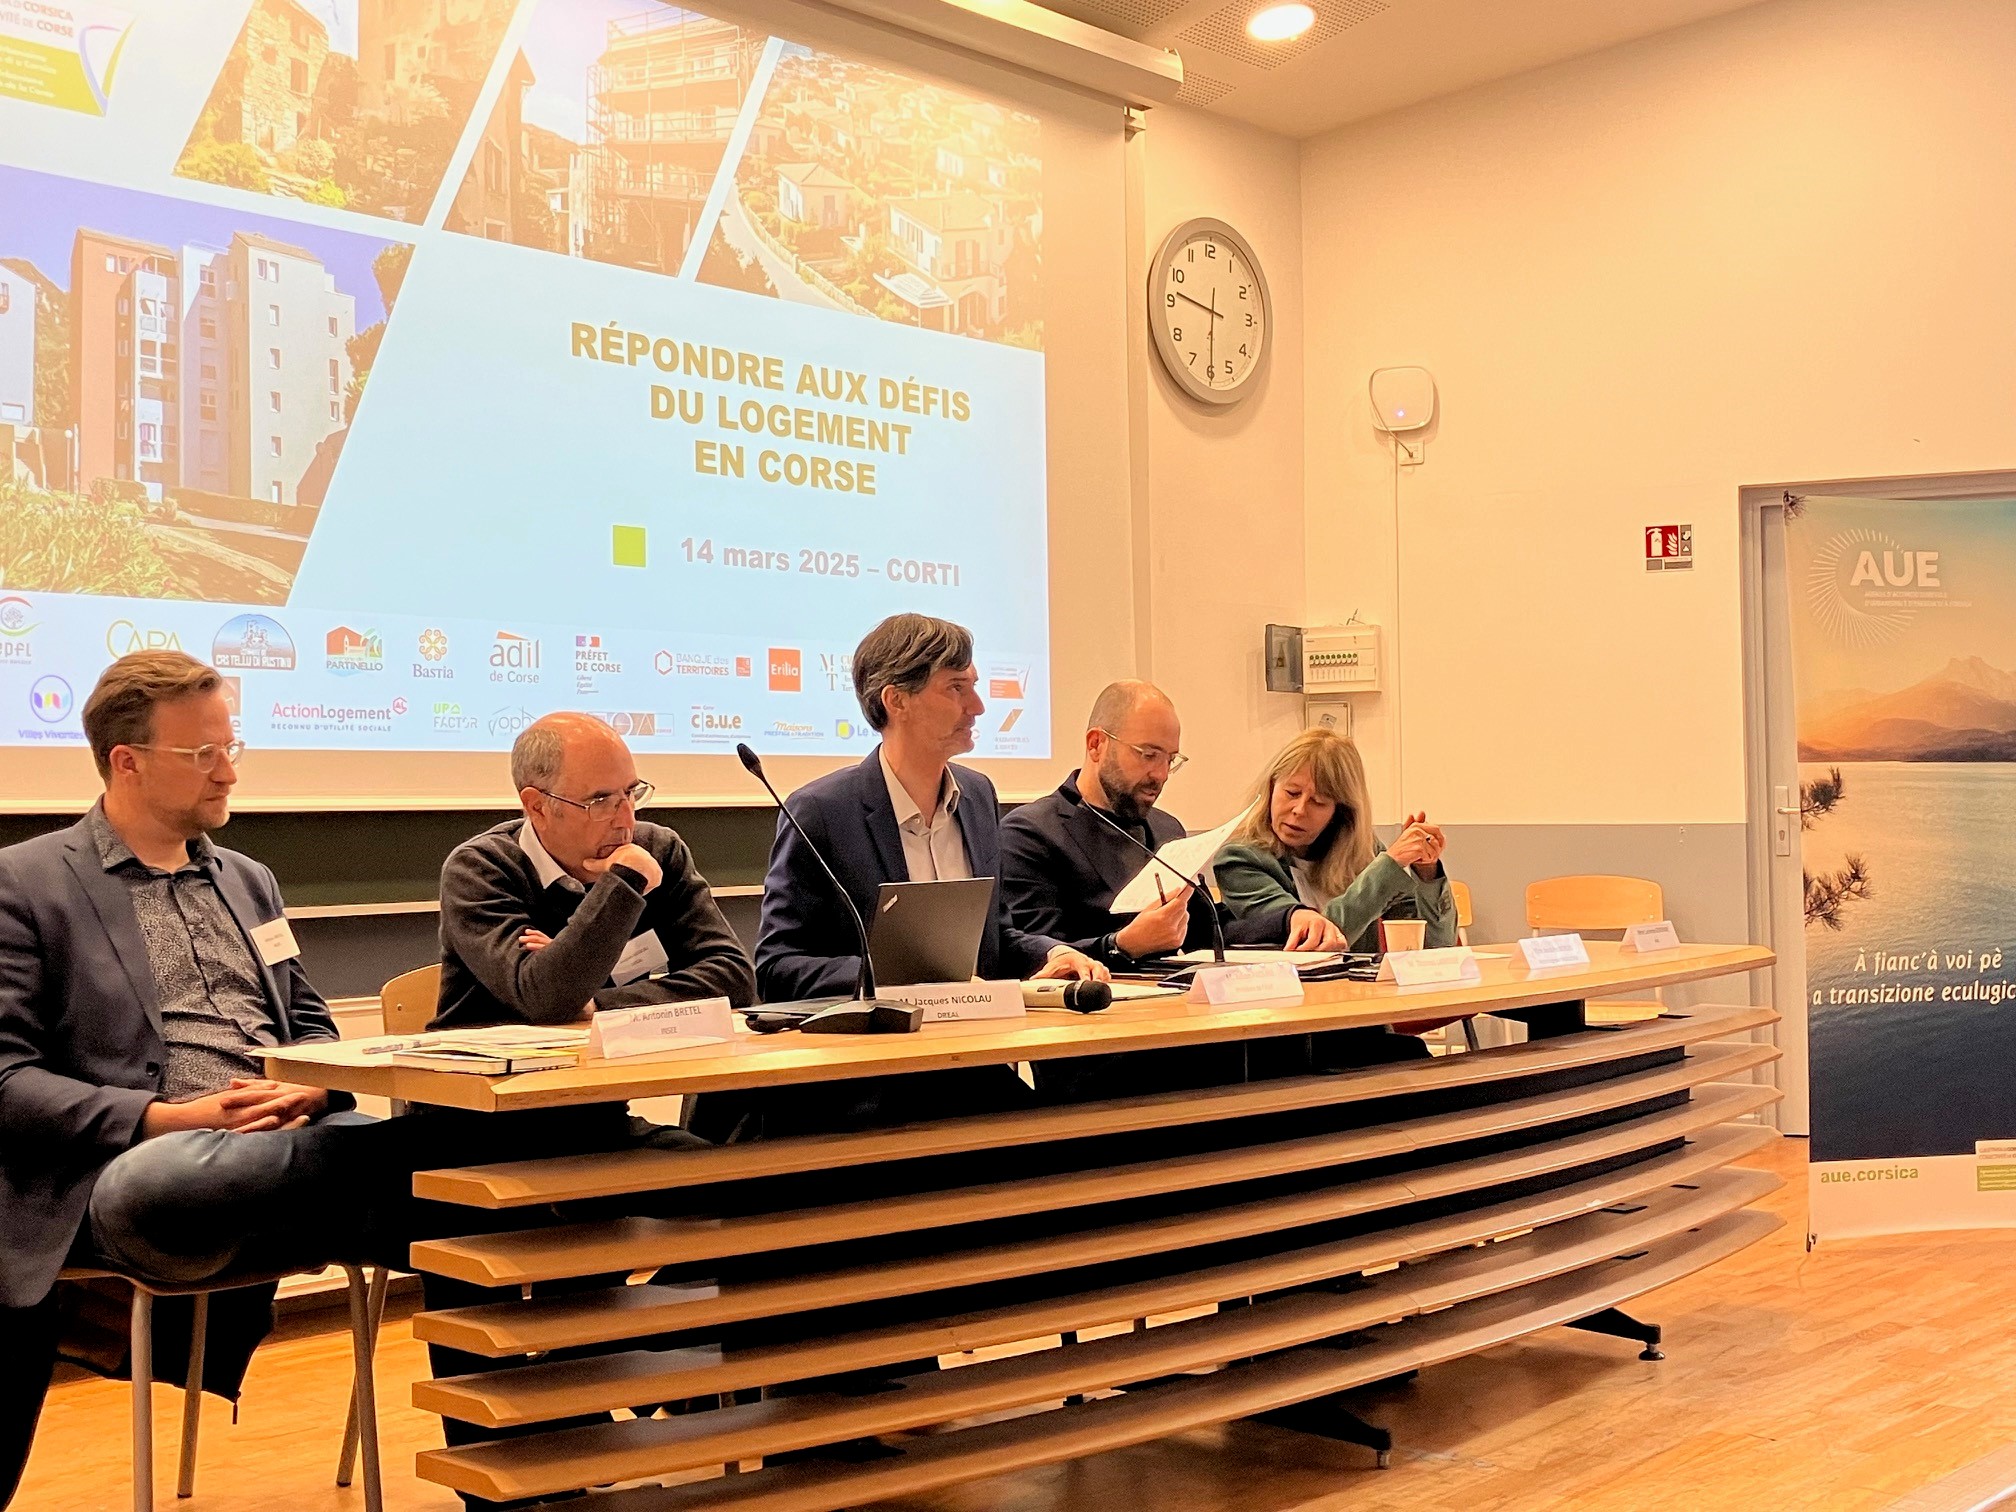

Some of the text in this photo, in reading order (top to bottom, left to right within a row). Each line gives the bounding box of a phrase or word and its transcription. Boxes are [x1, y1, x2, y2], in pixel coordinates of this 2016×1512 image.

[23, 1, 75, 22] CORSICA
[36, 20, 74, 38] CORSE
[1188, 248, 1194, 263] 11
[1204, 243, 1216, 260] 12
[1228, 259, 1232, 274] 1
[1172, 267, 1185, 284] 10
[1167, 293, 1176, 308] 9
[1239, 286, 1247, 300] 2
[1245, 313, 1253, 327] 3
[1173, 327, 1182, 342] 8
[1238, 343, 1247, 357] 4
[1188, 352, 1197, 366] 7
[571, 320, 971, 422] RÉPONDRE AUX DÉFIS
[1206, 365, 1215, 380] 6
[1225, 360, 1233, 374] 5
[651, 384, 912, 455] DU LOGEMENT
[695, 440, 876, 495] EN CORSE
[681, 537, 714, 564] 14
[723, 544, 790, 571] mars
[799, 549, 860, 578] 2025
[887, 558, 960, 587] CORTI
[1850, 550, 1941, 587] AUE
[489, 639, 540, 670] adil
[575, 649, 608, 661] PRÉFET
[676, 653, 712, 664] BANQUE
[326, 660, 384, 671] PARTINELLO
[412, 663, 454, 679] Bastia
[575, 661, 621, 673] DE CORSE
[676, 664, 729, 676] TERRITOIRES
[770, 662, 799, 677] Erilia
[489, 671, 540, 684] de Corse
[271, 702, 392, 722] ActionLogement
[271, 723, 311, 731] RECONNU
[45, 730, 84, 740] Vivantes
[1854, 947, 1867, 972] À
[1945, 950, 1973, 971] voi
[1979, 947, 2002, 973] pè
[913, 997, 949, 1008] Jacques
[951, 995, 992, 1005] NICOLAU
[1812, 989, 1822, 1005] a
[1830, 983, 1934, 1005] transizione
[674, 1005, 702, 1018] BRETEL
[937, 1011, 960, 1019] DREAL
[1819, 1165, 1919, 1184] aue.corsica
